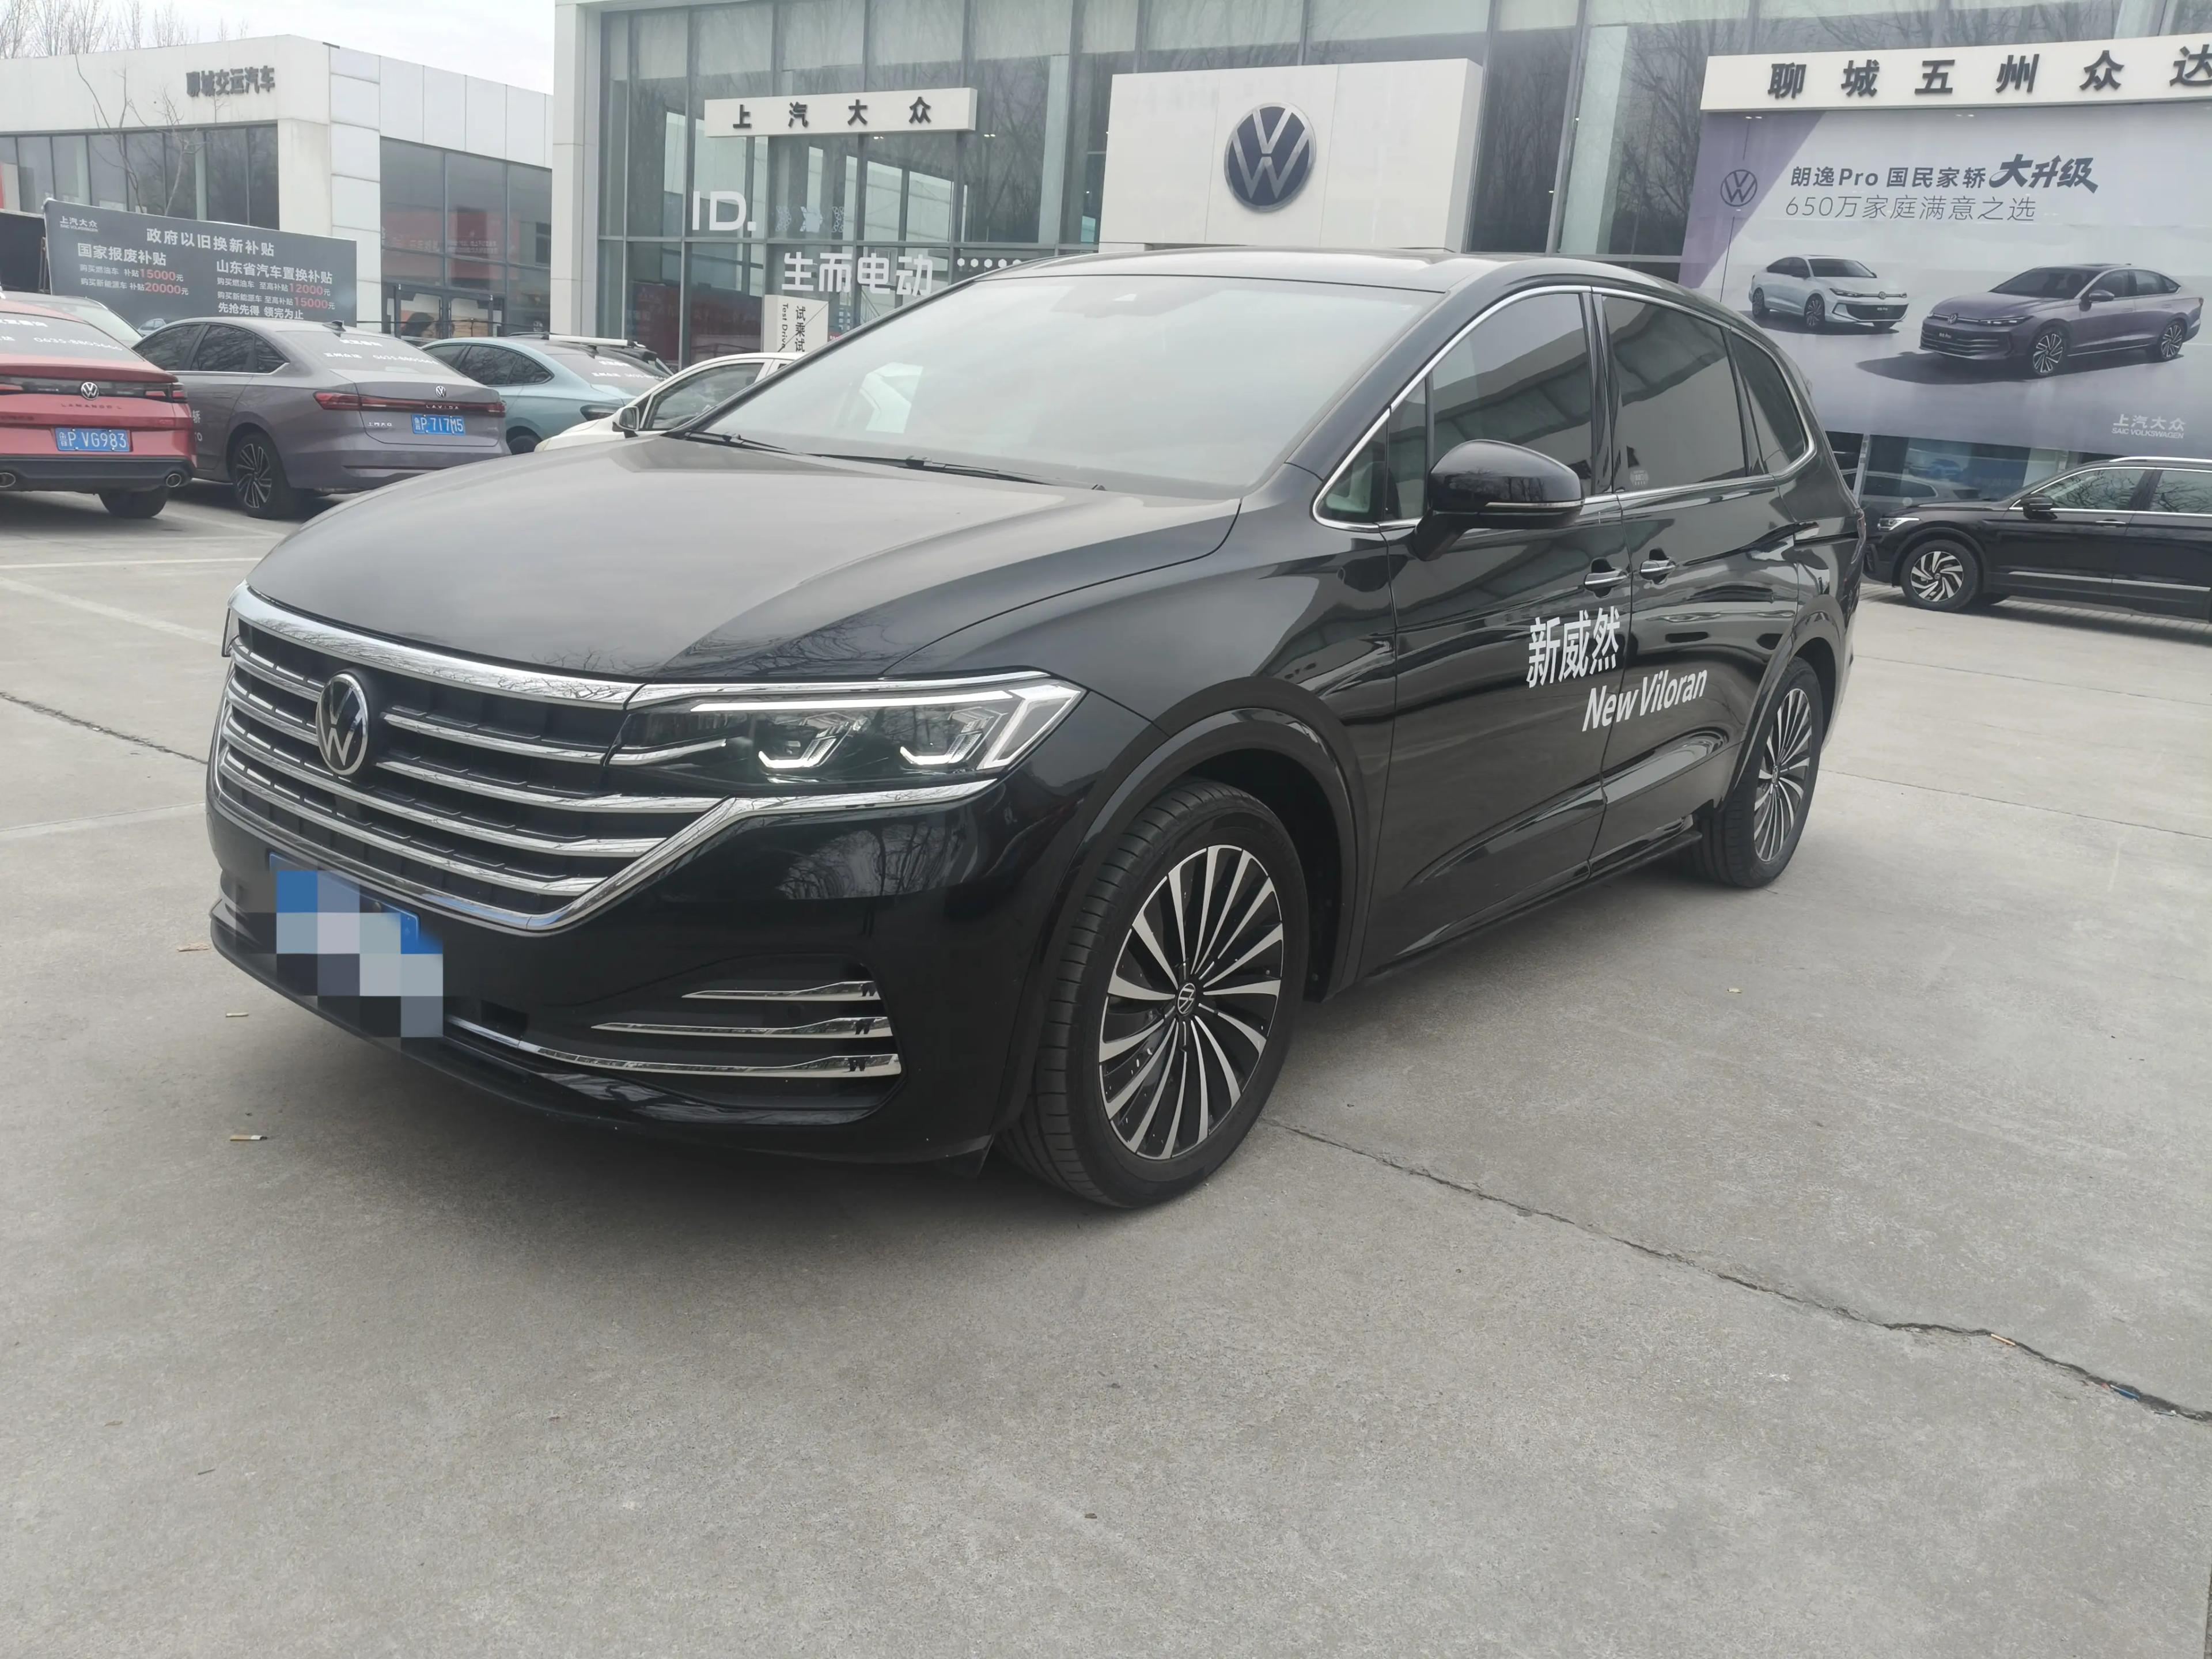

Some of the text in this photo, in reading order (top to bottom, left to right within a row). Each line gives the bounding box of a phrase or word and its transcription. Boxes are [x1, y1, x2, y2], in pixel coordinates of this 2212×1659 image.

[1767, 44, 2212, 99] 聊城五州众达
[732, 96, 932, 129] 上汽大众
[1785, 194, 2036, 221] 650万家庭满意之选
[59, 215, 98, 228] 上汽大众
[77, 243, 166, 266] 国家报废补贴
[146, 228, 275, 257] 政府以旧换新补贴
[216, 259, 333, 285] 山东省汽车置换补贴
[782, 251, 934, 297] 生而电动
[218, 302, 304, 320] 先抢先得 领完为止
[2113, 414, 2186, 432] 上汽大众
[2131, 429, 2185, 440] VOLKSWAGEN
[1527, 606, 1620, 688] 新威然
[1582, 669, 1708, 732] New Viloran
